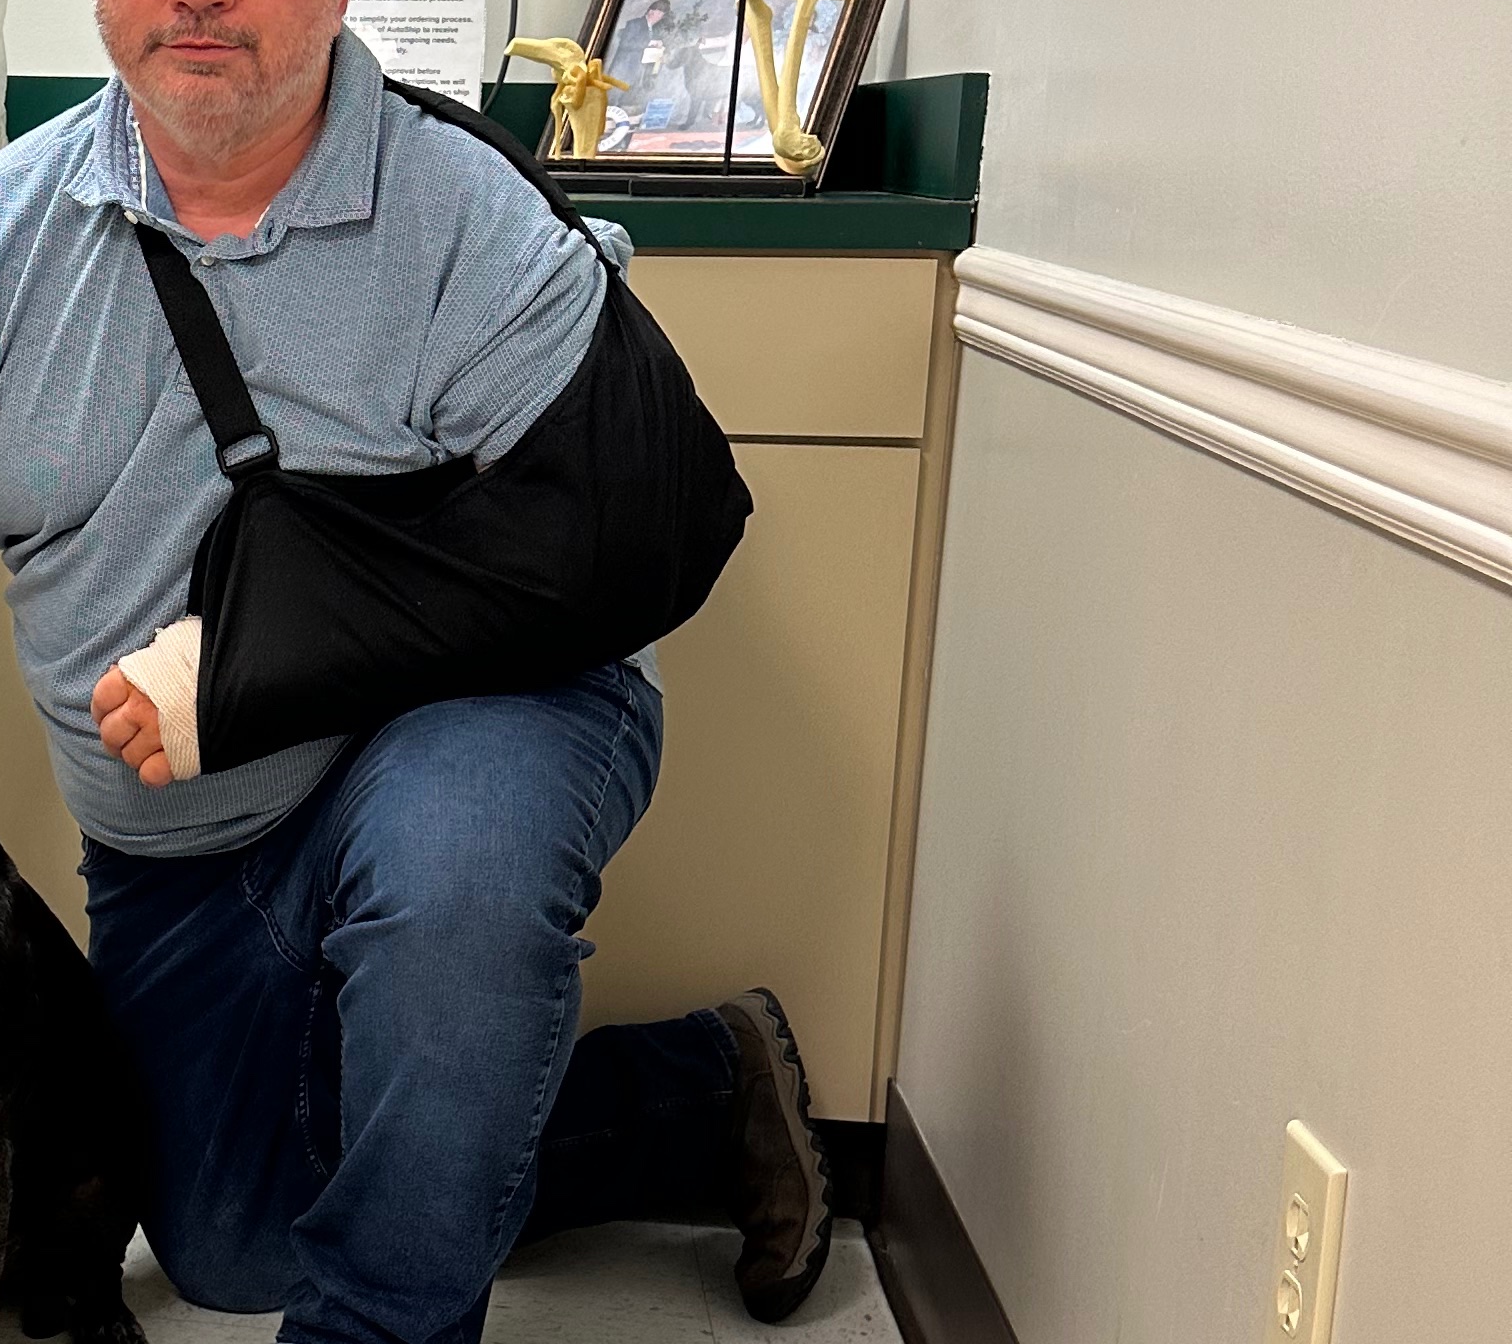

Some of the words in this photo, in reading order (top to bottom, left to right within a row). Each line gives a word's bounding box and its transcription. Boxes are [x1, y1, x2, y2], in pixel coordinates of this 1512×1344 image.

[359, 16, 388, 24] simplify
[390, 16, 407, 24] your
[408, 16, 439, 24] ordering
[441, 16, 473, 24] process.
